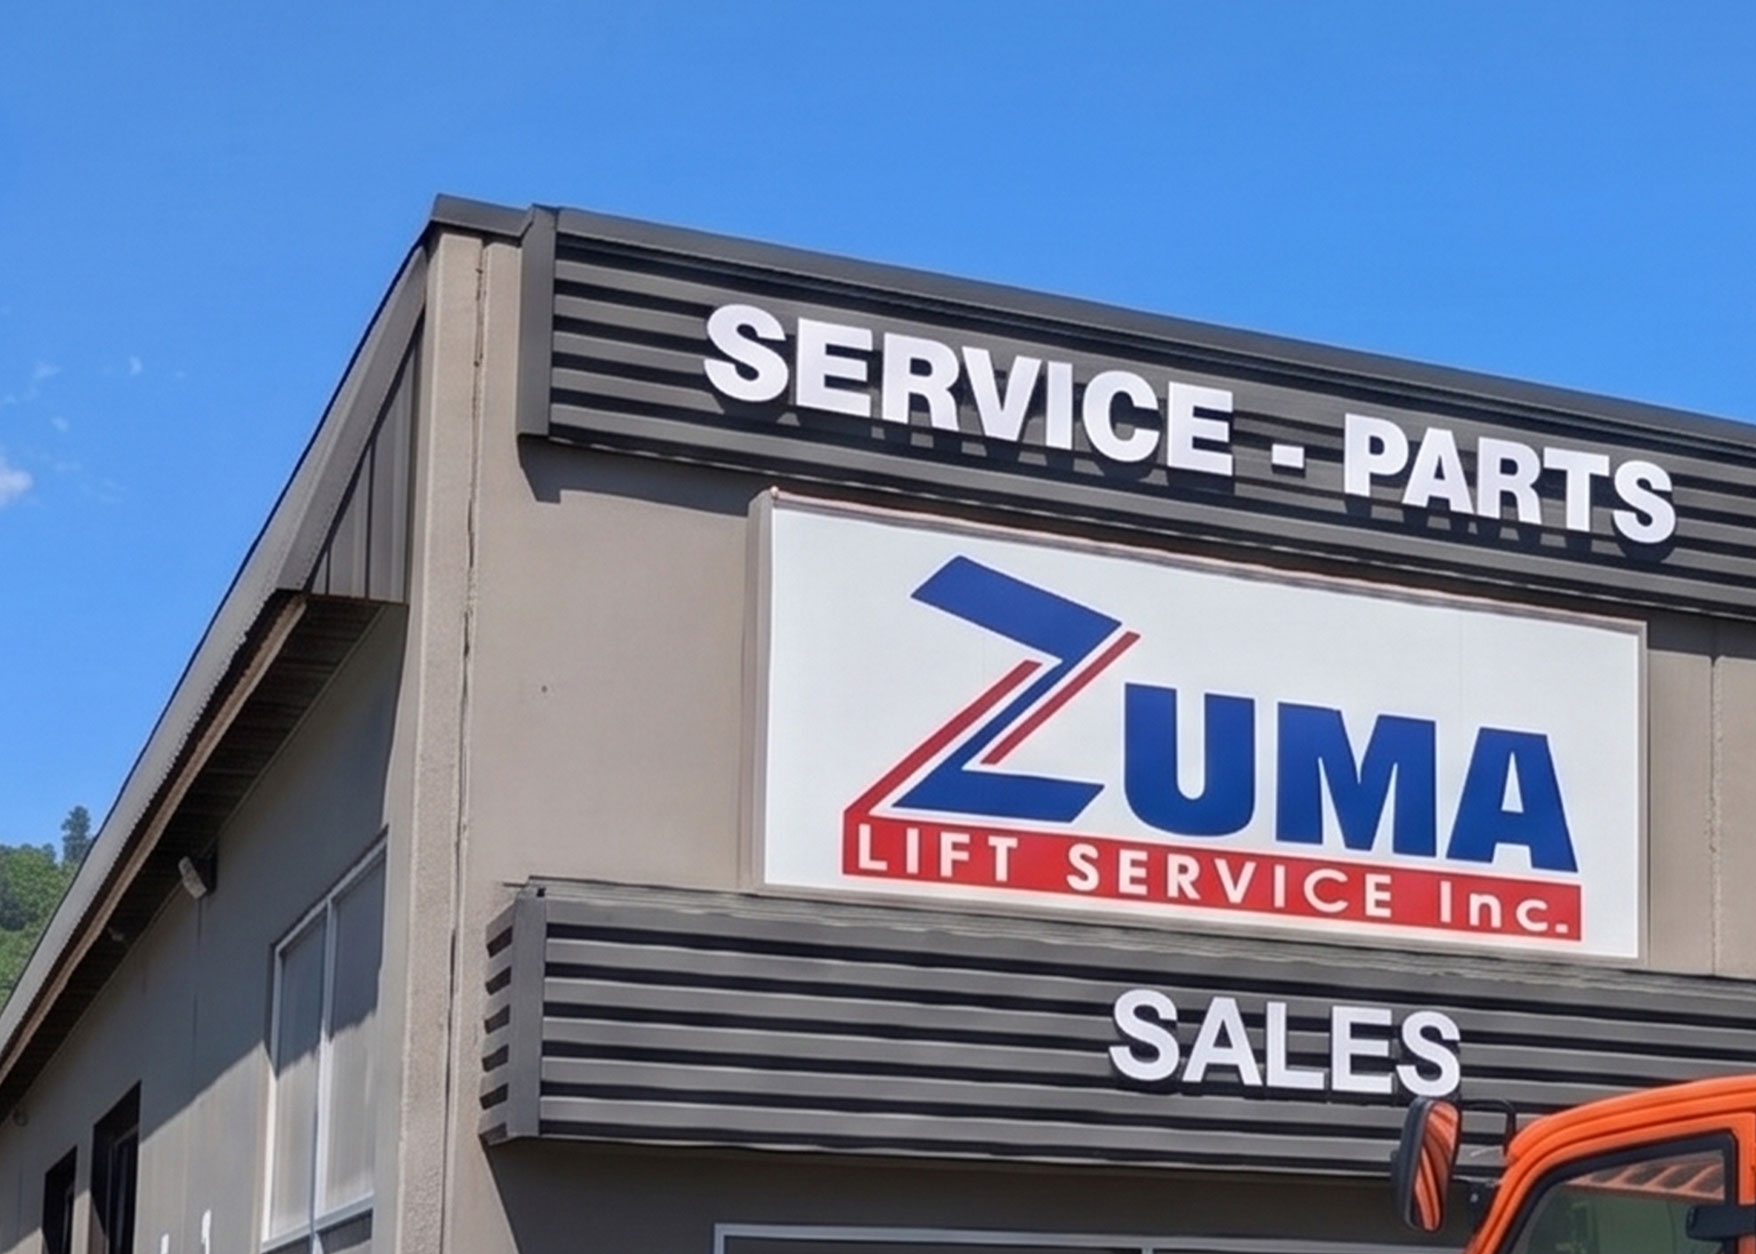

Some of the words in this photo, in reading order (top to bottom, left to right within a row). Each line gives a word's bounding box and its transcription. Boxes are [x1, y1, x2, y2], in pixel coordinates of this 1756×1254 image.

[703, 303, 1234, 477] SERVICE
[1342, 412, 1677, 544] PARTS
[890, 554, 1579, 873] ZUMA
[857, 822, 1019, 883] LIFT
[1066, 842, 1392, 918] SERVICE
[1439, 880, 1568, 933] Inc.
[1108, 988, 1462, 1097] SALES
